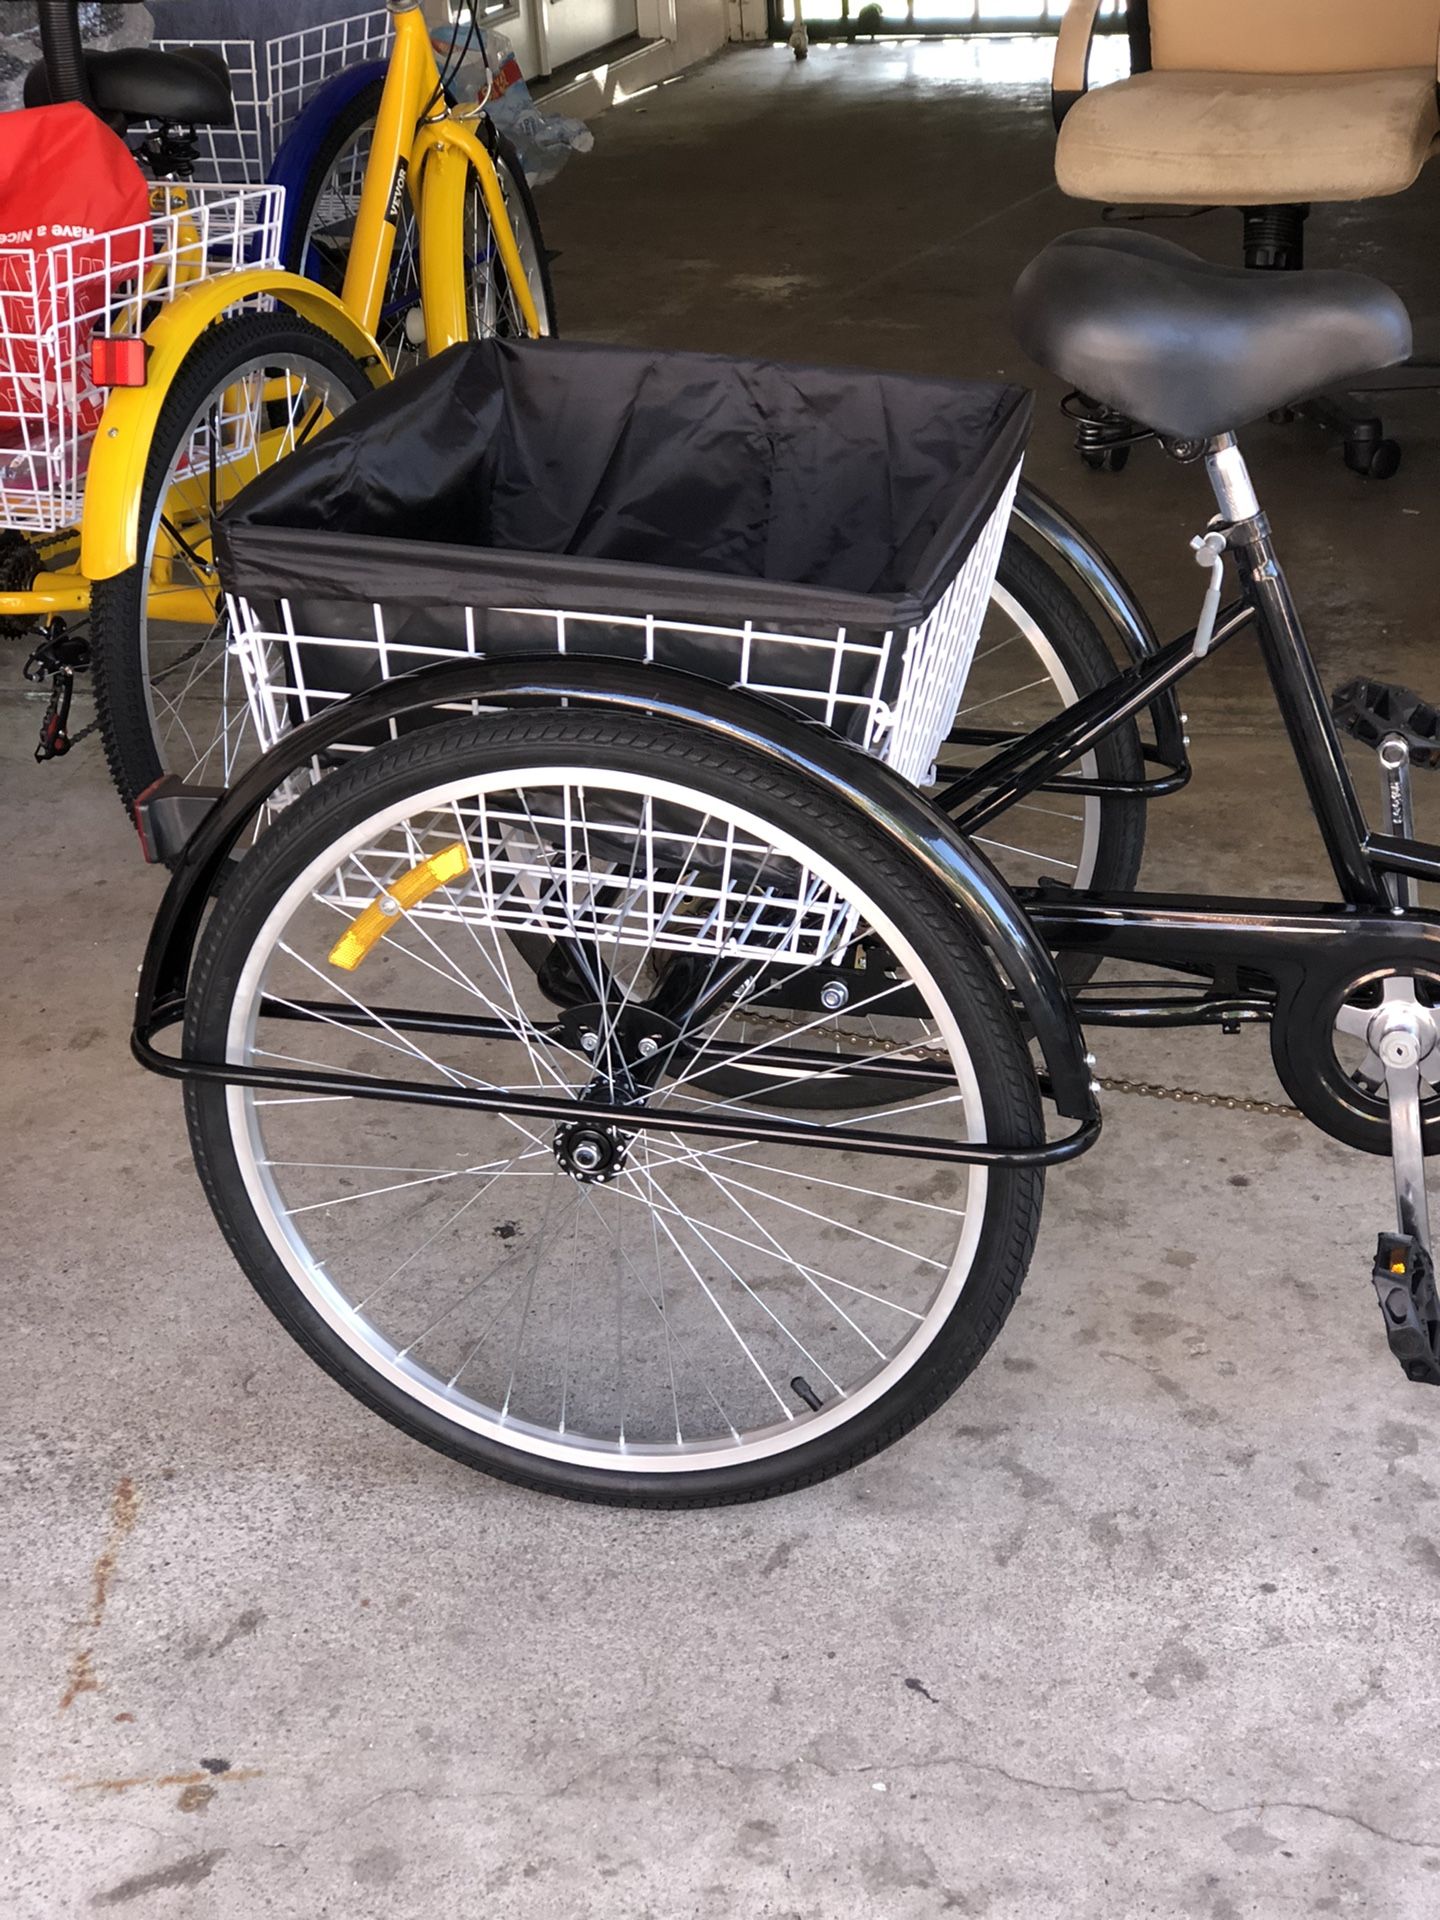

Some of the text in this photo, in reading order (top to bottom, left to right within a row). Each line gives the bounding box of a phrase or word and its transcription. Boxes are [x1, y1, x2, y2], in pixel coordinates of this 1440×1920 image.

[390, 168, 407, 215] VEVOR
[0, 224, 95, 244] Have a Nice
